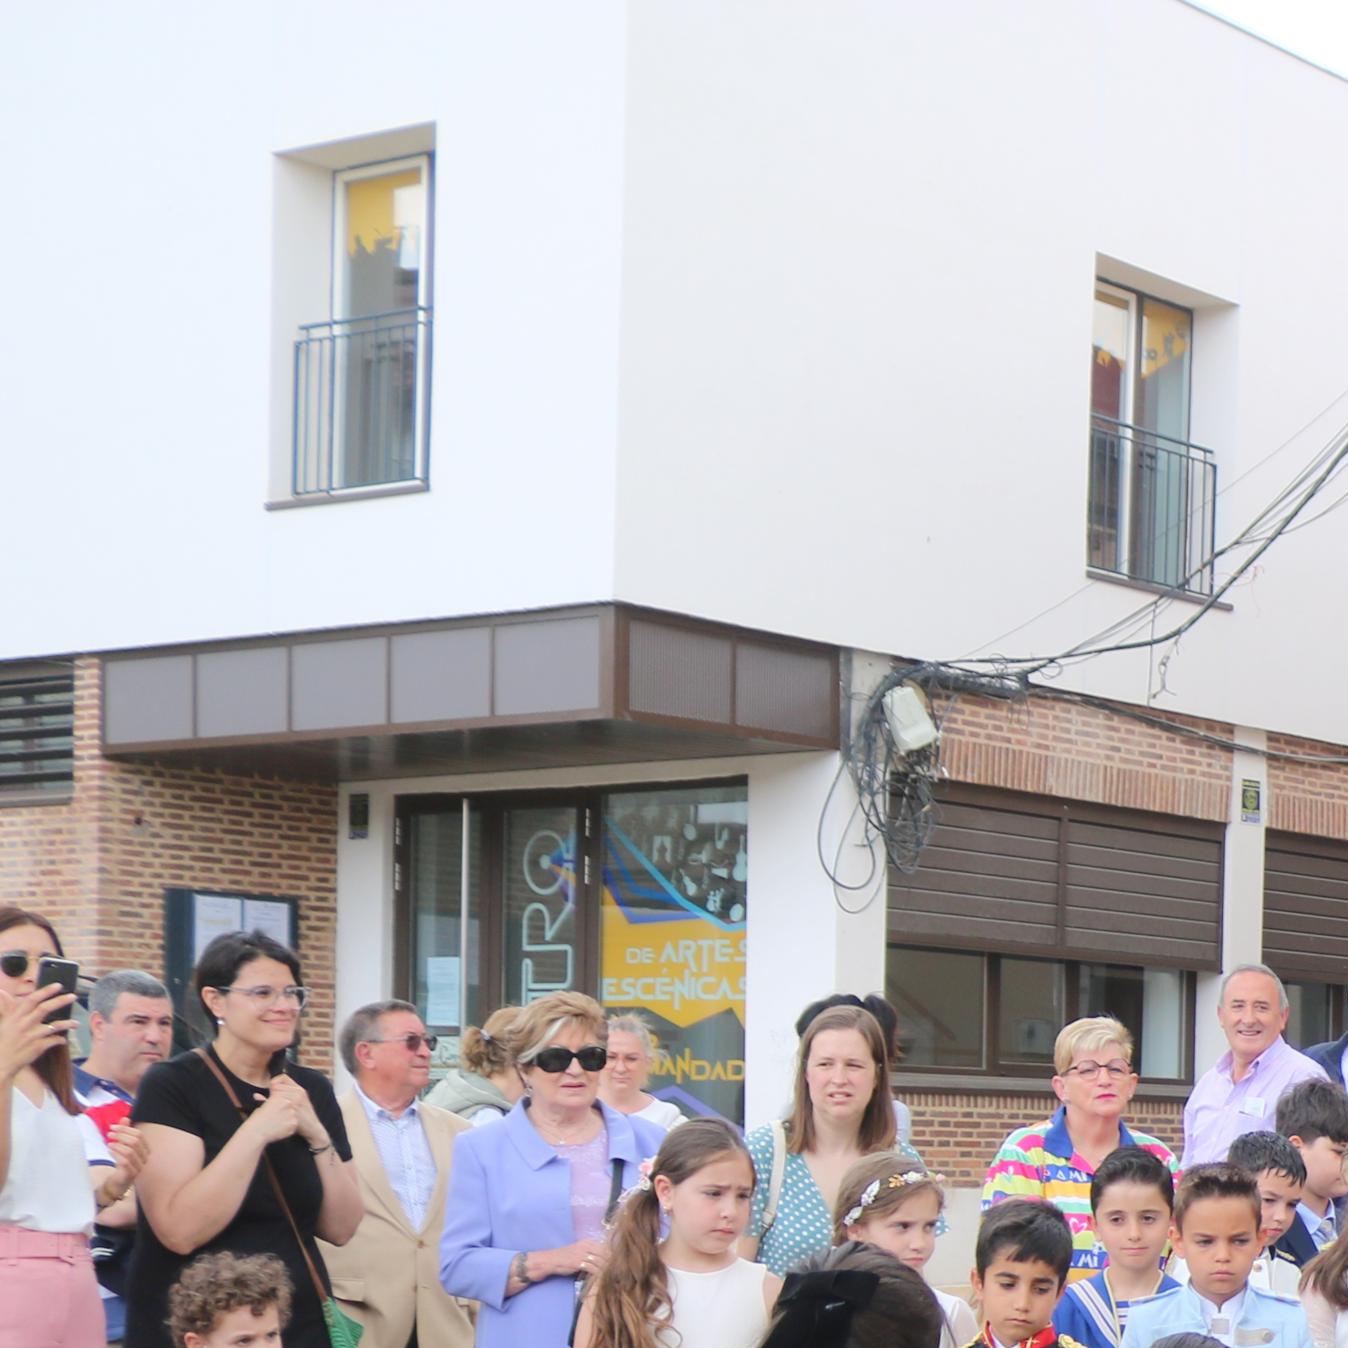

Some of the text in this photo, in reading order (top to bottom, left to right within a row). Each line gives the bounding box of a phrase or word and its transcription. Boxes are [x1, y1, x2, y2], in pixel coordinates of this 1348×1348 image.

[625, 938, 746, 973] DE ARTES
[601, 968, 746, 1010] ESCÉNICAS
